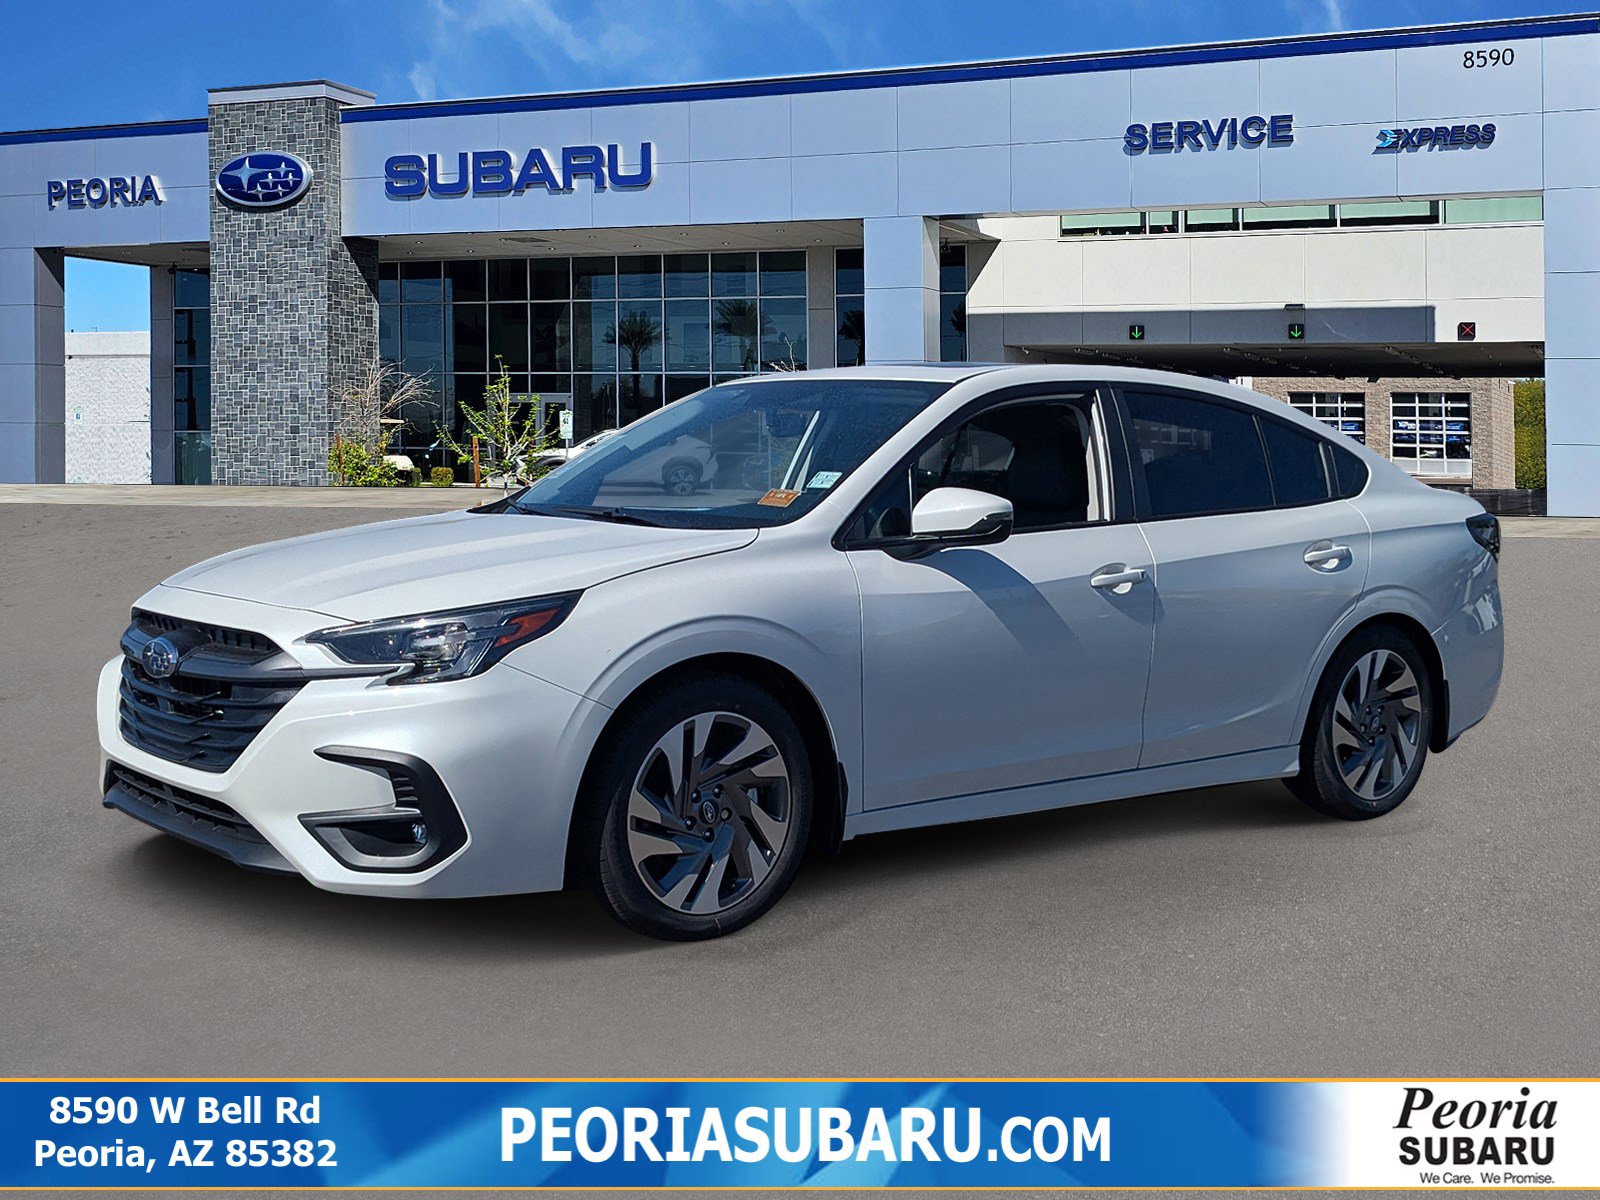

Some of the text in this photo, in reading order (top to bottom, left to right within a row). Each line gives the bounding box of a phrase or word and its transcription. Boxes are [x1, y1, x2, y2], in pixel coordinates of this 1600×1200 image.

[1462, 47, 1515, 69] 8590
[1123, 114, 1294, 153] SERVICE
[1375, 122, 1497, 150] EXPRESS
[384, 141, 653, 199] SUBARU
[47, 174, 161, 209] PEORIA
